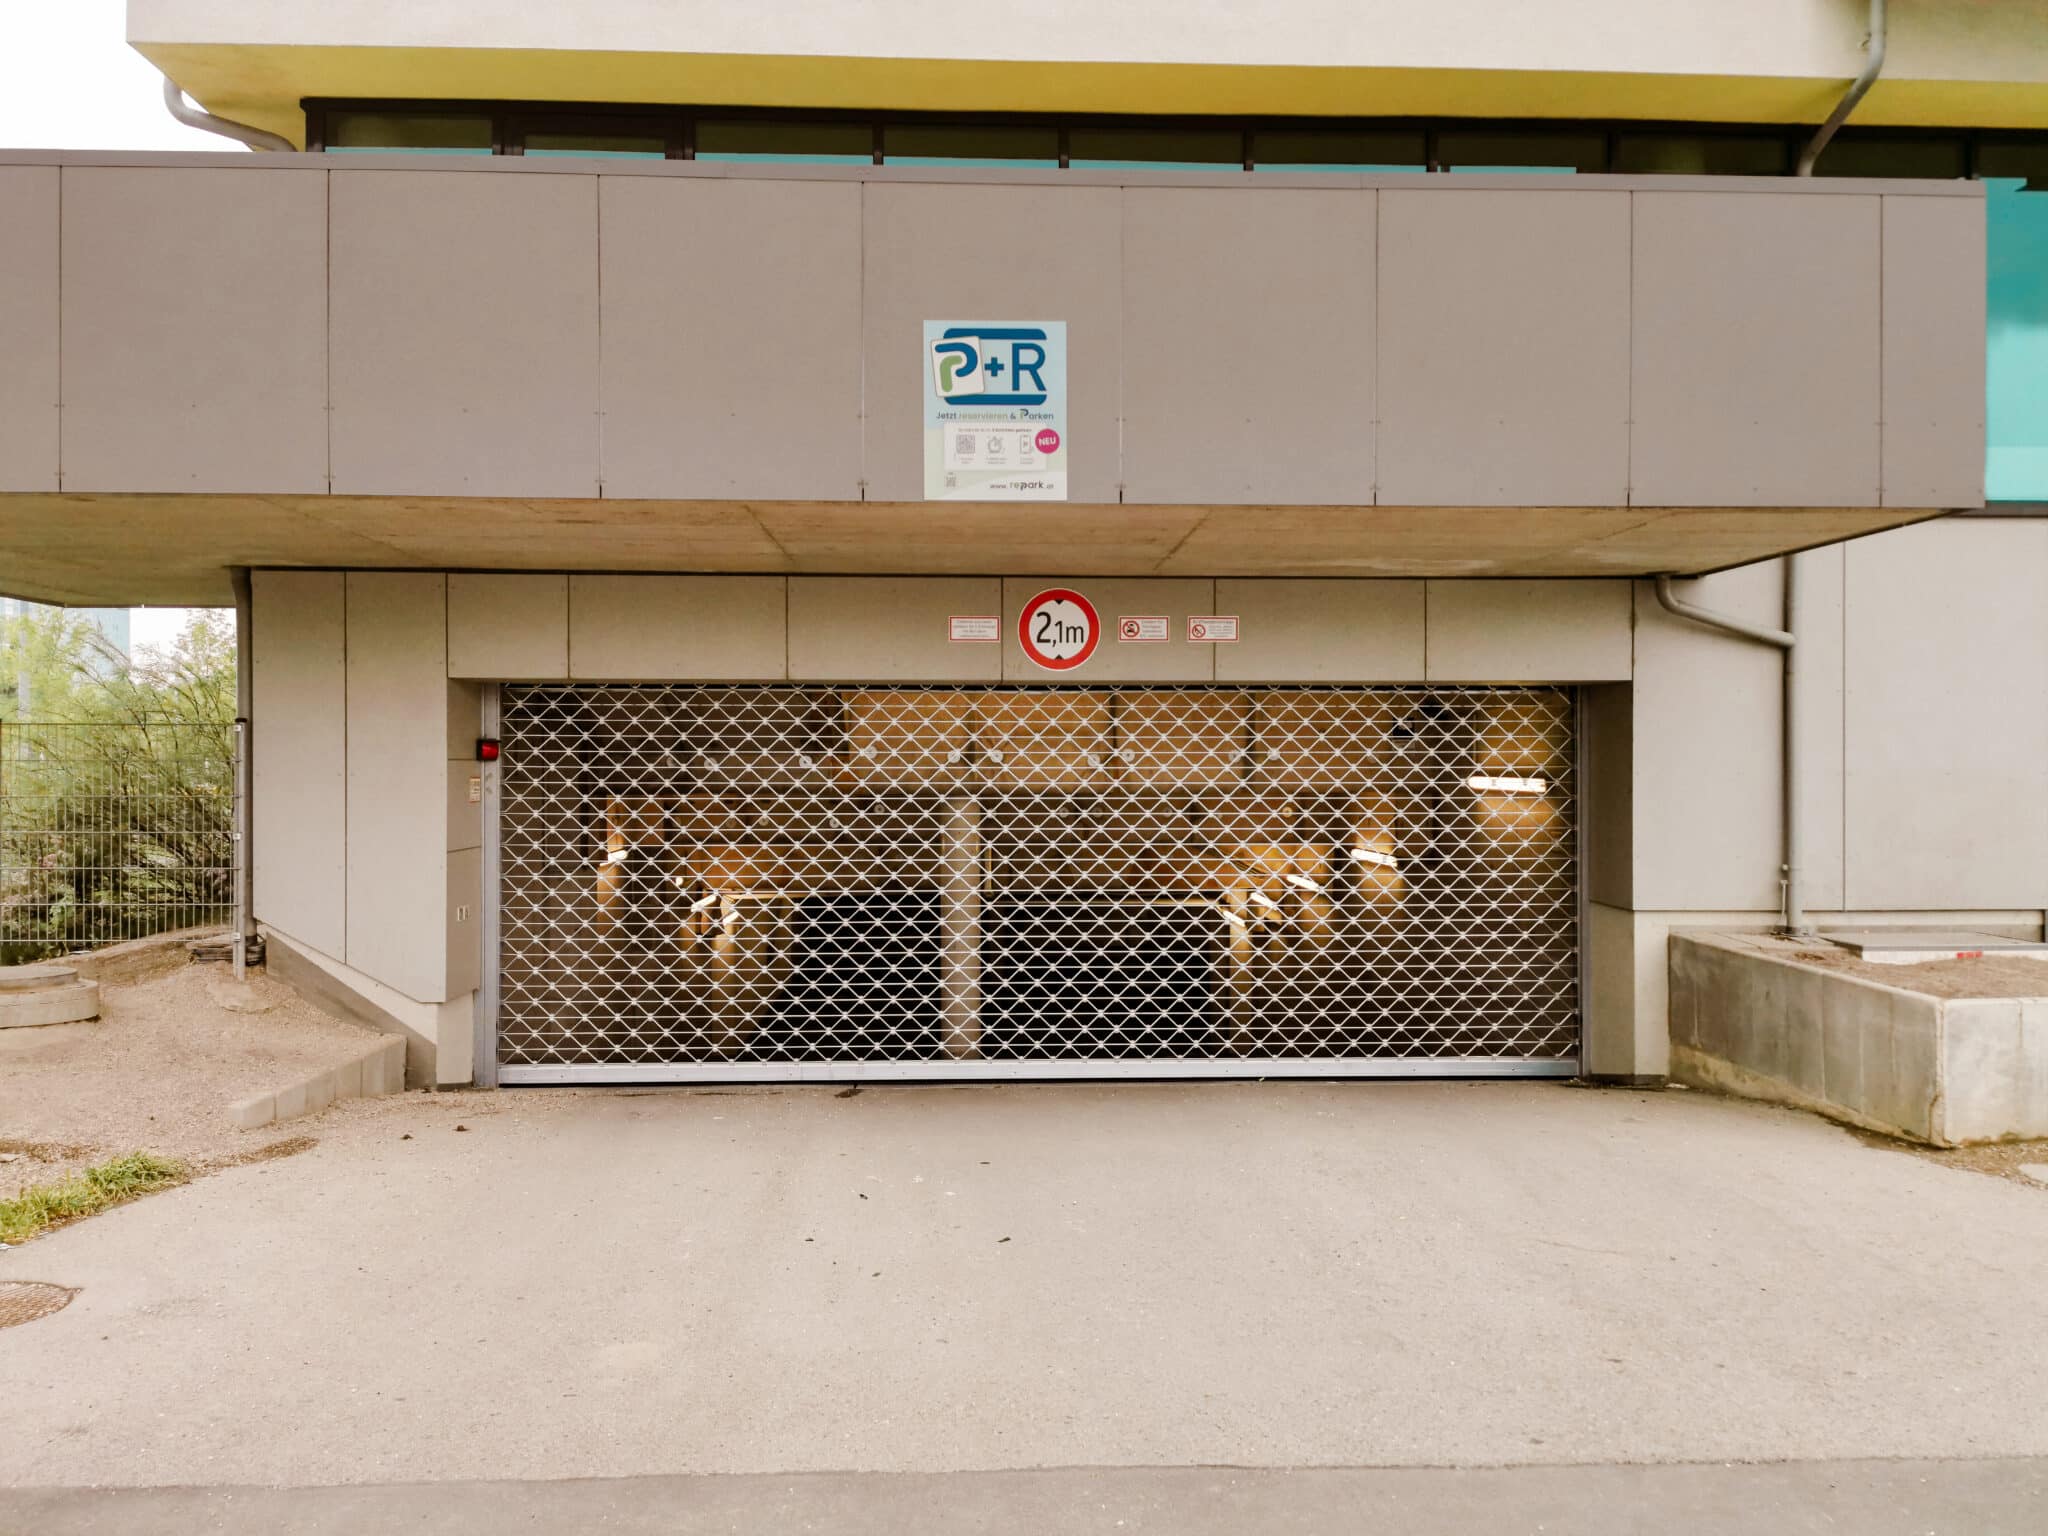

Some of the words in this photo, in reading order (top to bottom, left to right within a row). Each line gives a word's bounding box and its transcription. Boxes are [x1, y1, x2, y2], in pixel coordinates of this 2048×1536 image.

[935, 342, 1046, 392] P+R
[936, 410, 956, 420] Jetzt
[1019, 408, 1054, 420] Parken
[1038, 436, 1057, 446] NEU
